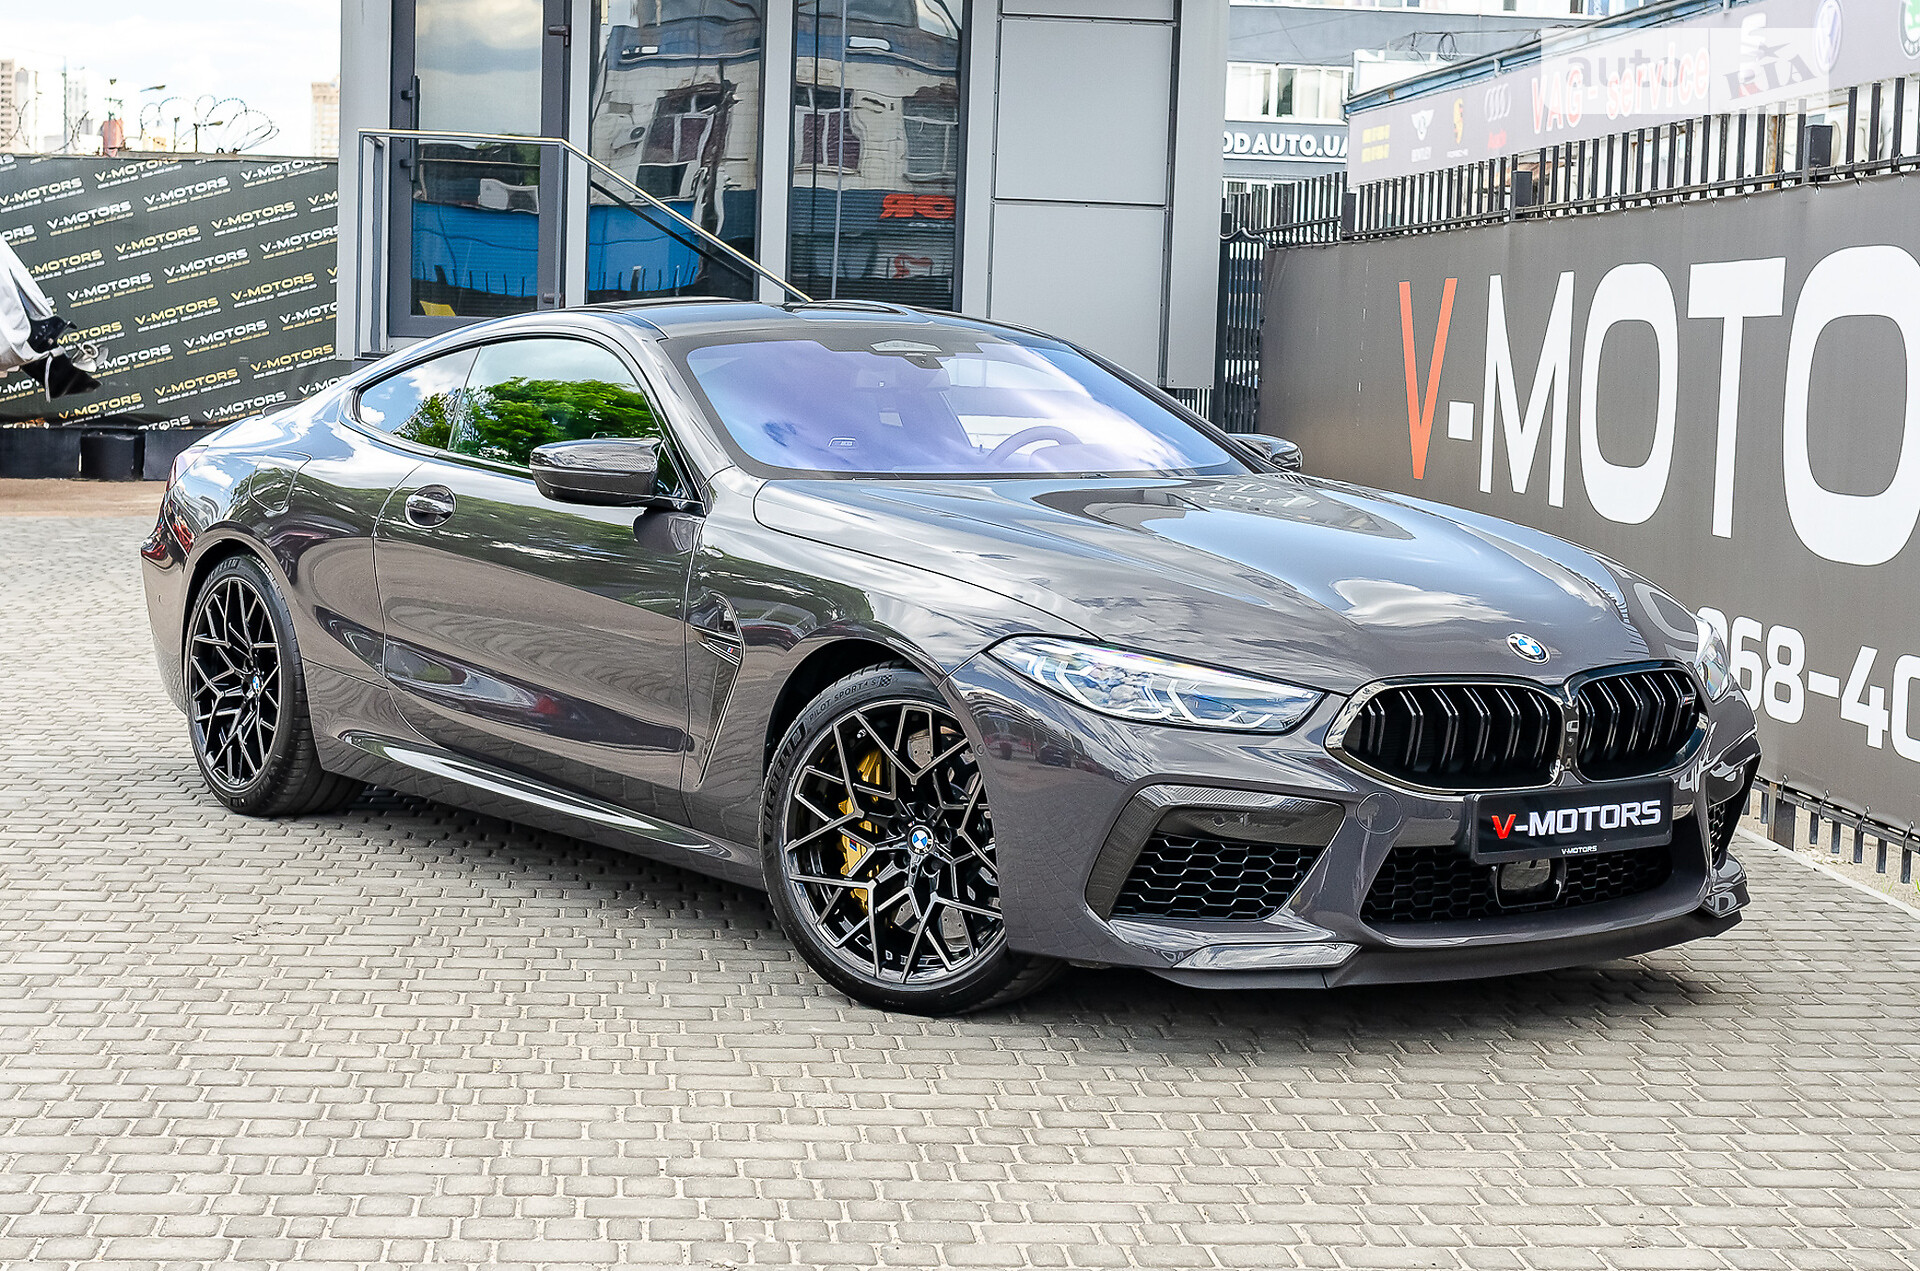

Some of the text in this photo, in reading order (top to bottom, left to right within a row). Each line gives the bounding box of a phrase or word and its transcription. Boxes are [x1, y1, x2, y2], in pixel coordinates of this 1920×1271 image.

[0, 177, 82, 206] V-MOTORS
[144, 177, 229, 205] V-MOTORS
[47, 201, 132, 230] V-MOTORS
[211, 201, 296, 229] V-MOTORS
[115, 225, 200, 254] V-MOTORS
[27, 249, 103, 275] -MOTORS
[164, 248, 248, 277] V-MOTORS
[67, 272, 152, 301] V-MOTORS
[231, 272, 315, 301] V-MOTORS
[135, 297, 219, 325] V-MOTORS
[279, 302, 338, 324] V-MOTO
[57, 321, 122, 345] MOTORS
[183, 320, 268, 349] V-MOTORS
[97, 344, 172, 370] -MOTORS
[250, 344, 334, 372] V-MOTORS
[155, 368, 238, 397] V-MOTORS
[58, 392, 143, 419] V-MOTORS
[203, 391, 287, 419] V-MOTORS
[808, 699, 832, 721] PILOT
[834, 683, 865, 701] SPORT
[1491, 800, 1661, 840] V-MOTORS
[1561, 845, 1598, 855] V-MOTORS
